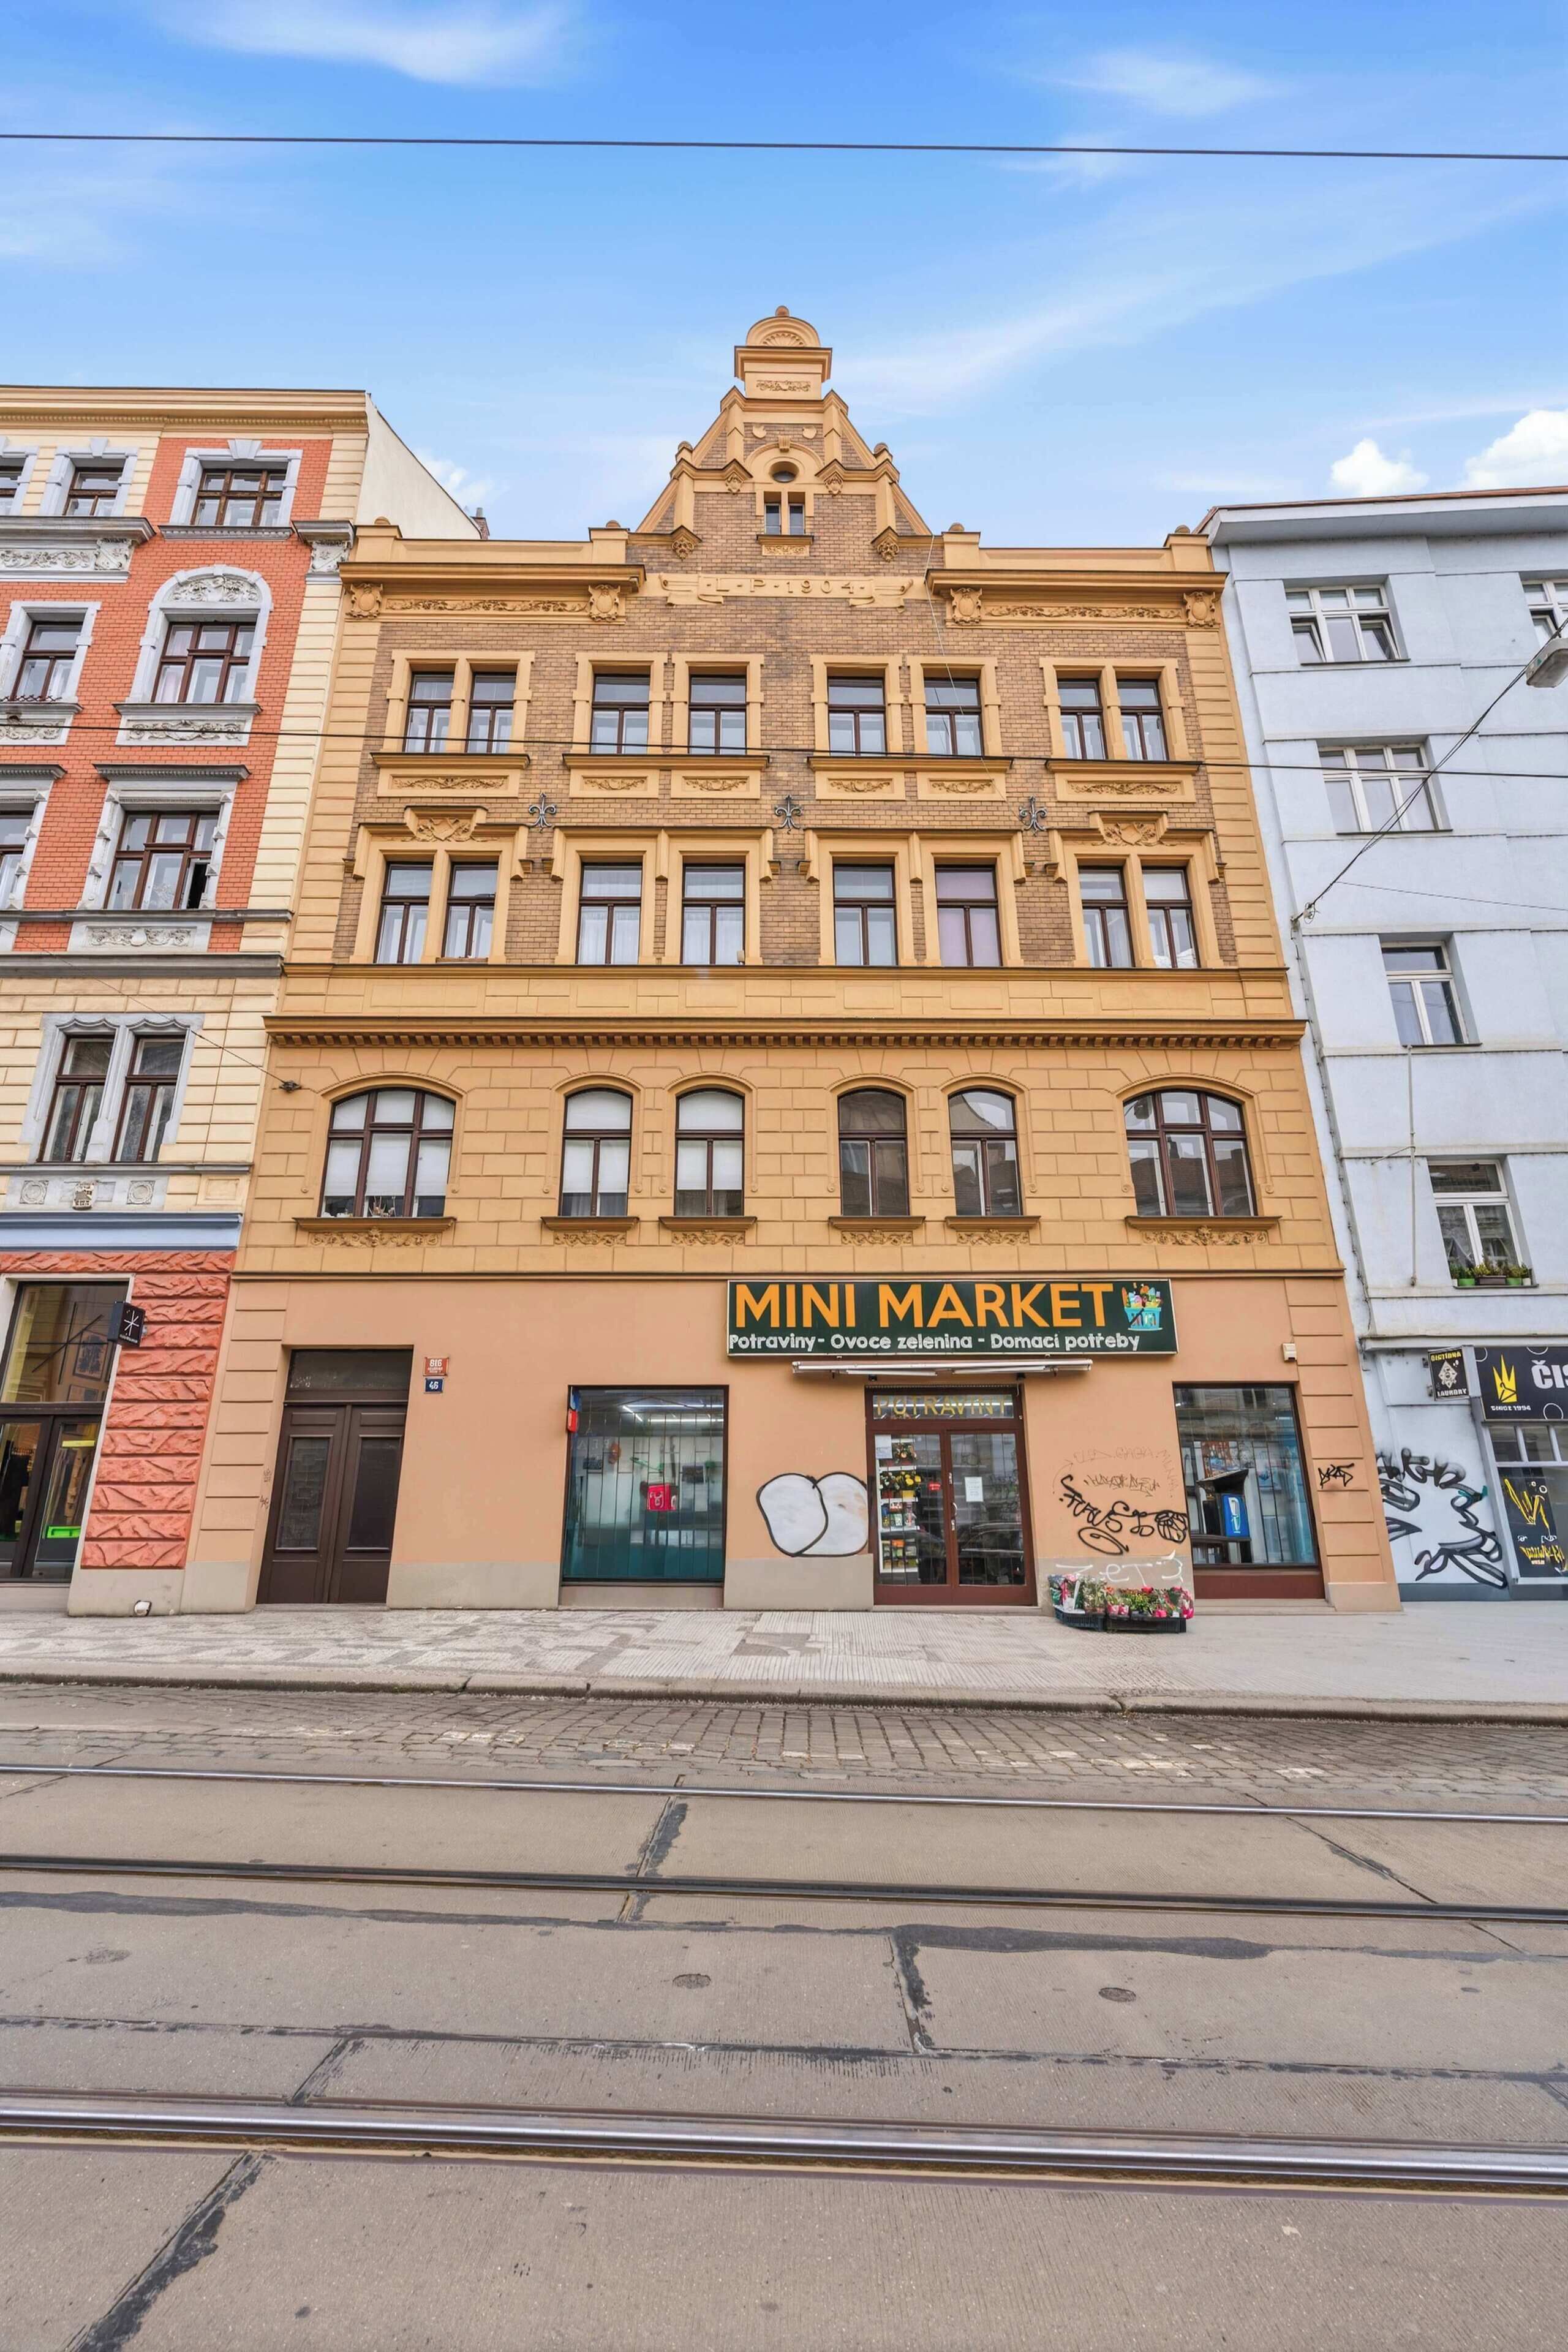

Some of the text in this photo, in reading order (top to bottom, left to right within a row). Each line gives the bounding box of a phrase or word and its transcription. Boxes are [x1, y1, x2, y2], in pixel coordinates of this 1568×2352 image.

[736, 1283, 1114, 1328] MINI MARKET
[831, 1333, 891, 1349] Ovoce
[897, 1333, 973, 1349] zelenina
[1065, 1332, 1140, 1352] potřeby
[429, 1381, 439, 1390] 46
